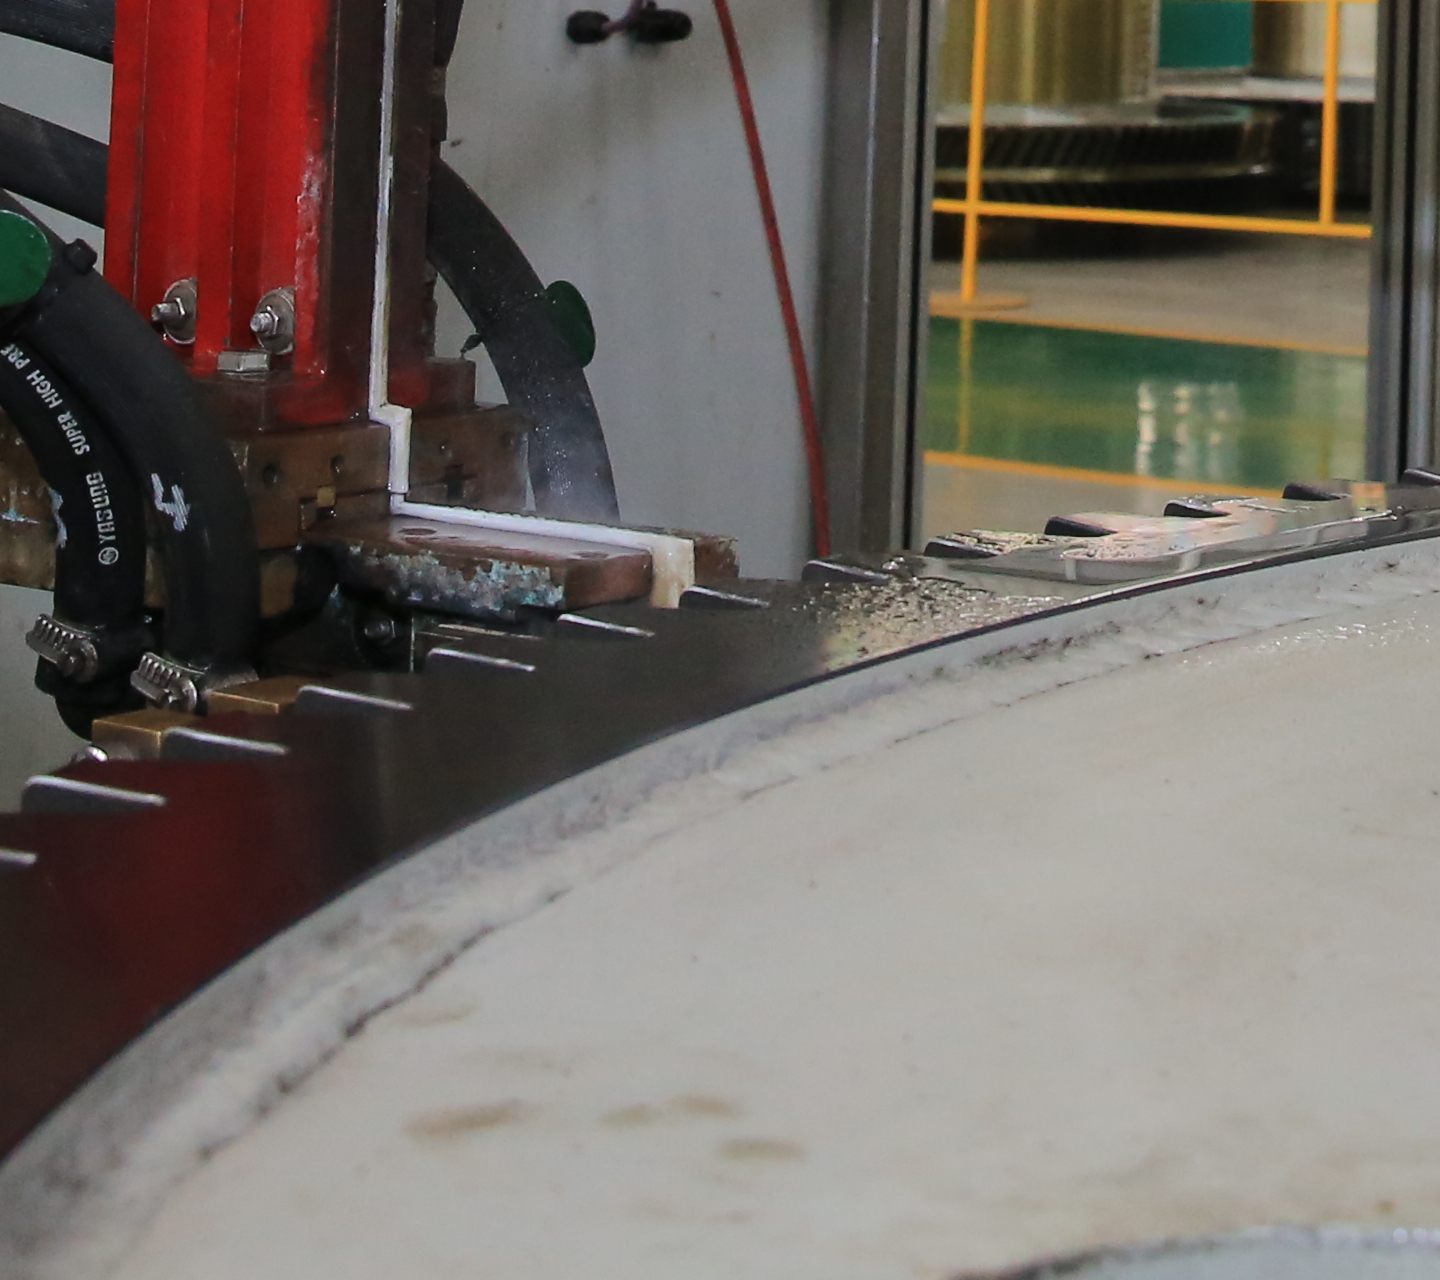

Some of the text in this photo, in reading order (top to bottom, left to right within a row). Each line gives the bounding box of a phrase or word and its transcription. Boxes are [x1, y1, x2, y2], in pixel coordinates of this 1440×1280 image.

[26, 369, 63, 409] HIGH
[56, 410, 91, 455] SUPER
[85, 470, 116, 544] YASUNG
